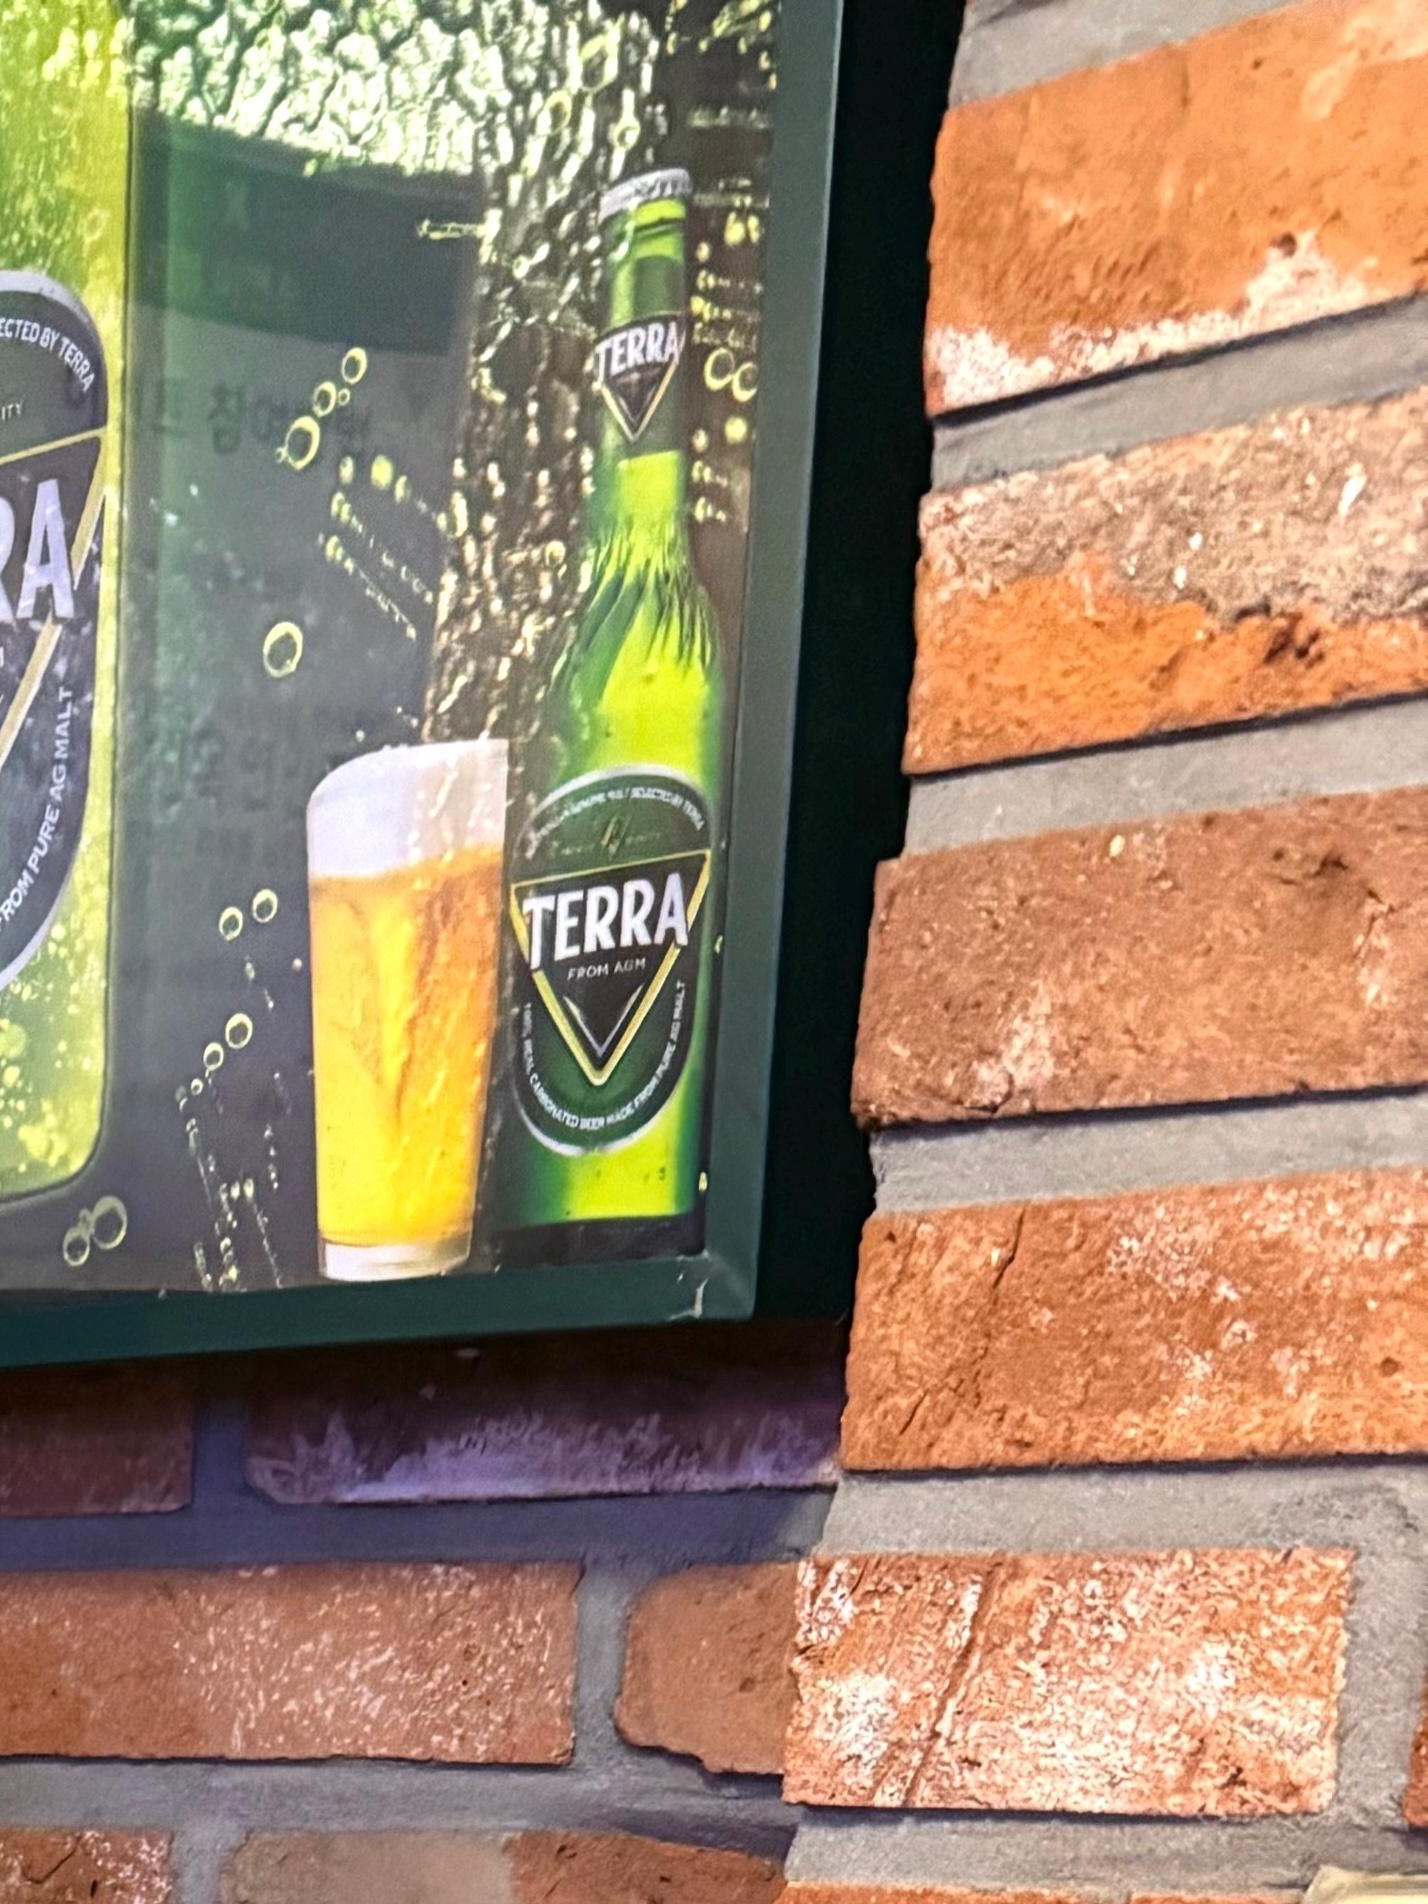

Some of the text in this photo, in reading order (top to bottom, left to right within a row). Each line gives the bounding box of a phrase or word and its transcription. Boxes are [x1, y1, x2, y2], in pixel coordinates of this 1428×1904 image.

[40, 325, 59, 353] BY
[58, 336, 96, 395] TERRA
[594, 321, 680, 383] TERRA
[52, 685, 73, 760] MALT
[48, 765, 67, 803] AG
[26, 804, 60, 875] PURE
[522, 872, 689, 971] TERRA
[567, 957, 647, 981] FROM AGM
